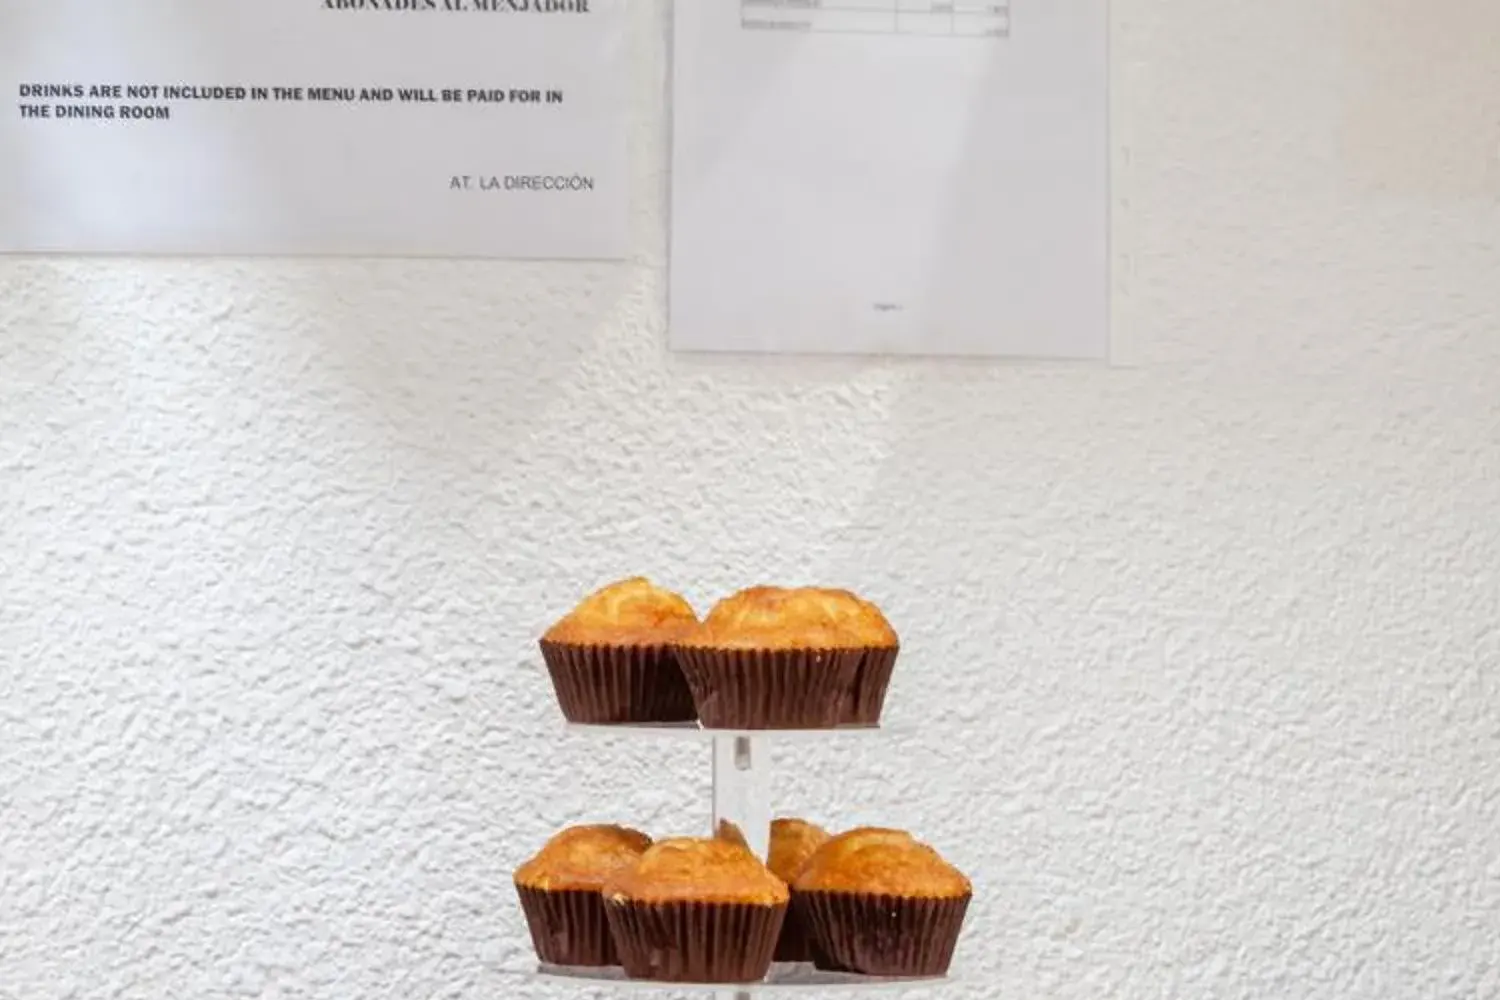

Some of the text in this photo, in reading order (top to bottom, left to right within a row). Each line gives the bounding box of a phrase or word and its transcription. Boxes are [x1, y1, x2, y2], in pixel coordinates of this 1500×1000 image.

[18, 83, 564, 103] DRINKS ARE NOT INCLUDED IN THE MENU AND WILL BE PAID FOR IN
[18, 104, 171, 121] THE DINING ROOM
[479, 175, 501, 191] LA
[503, 174, 595, 192] DIRECCIÓN
